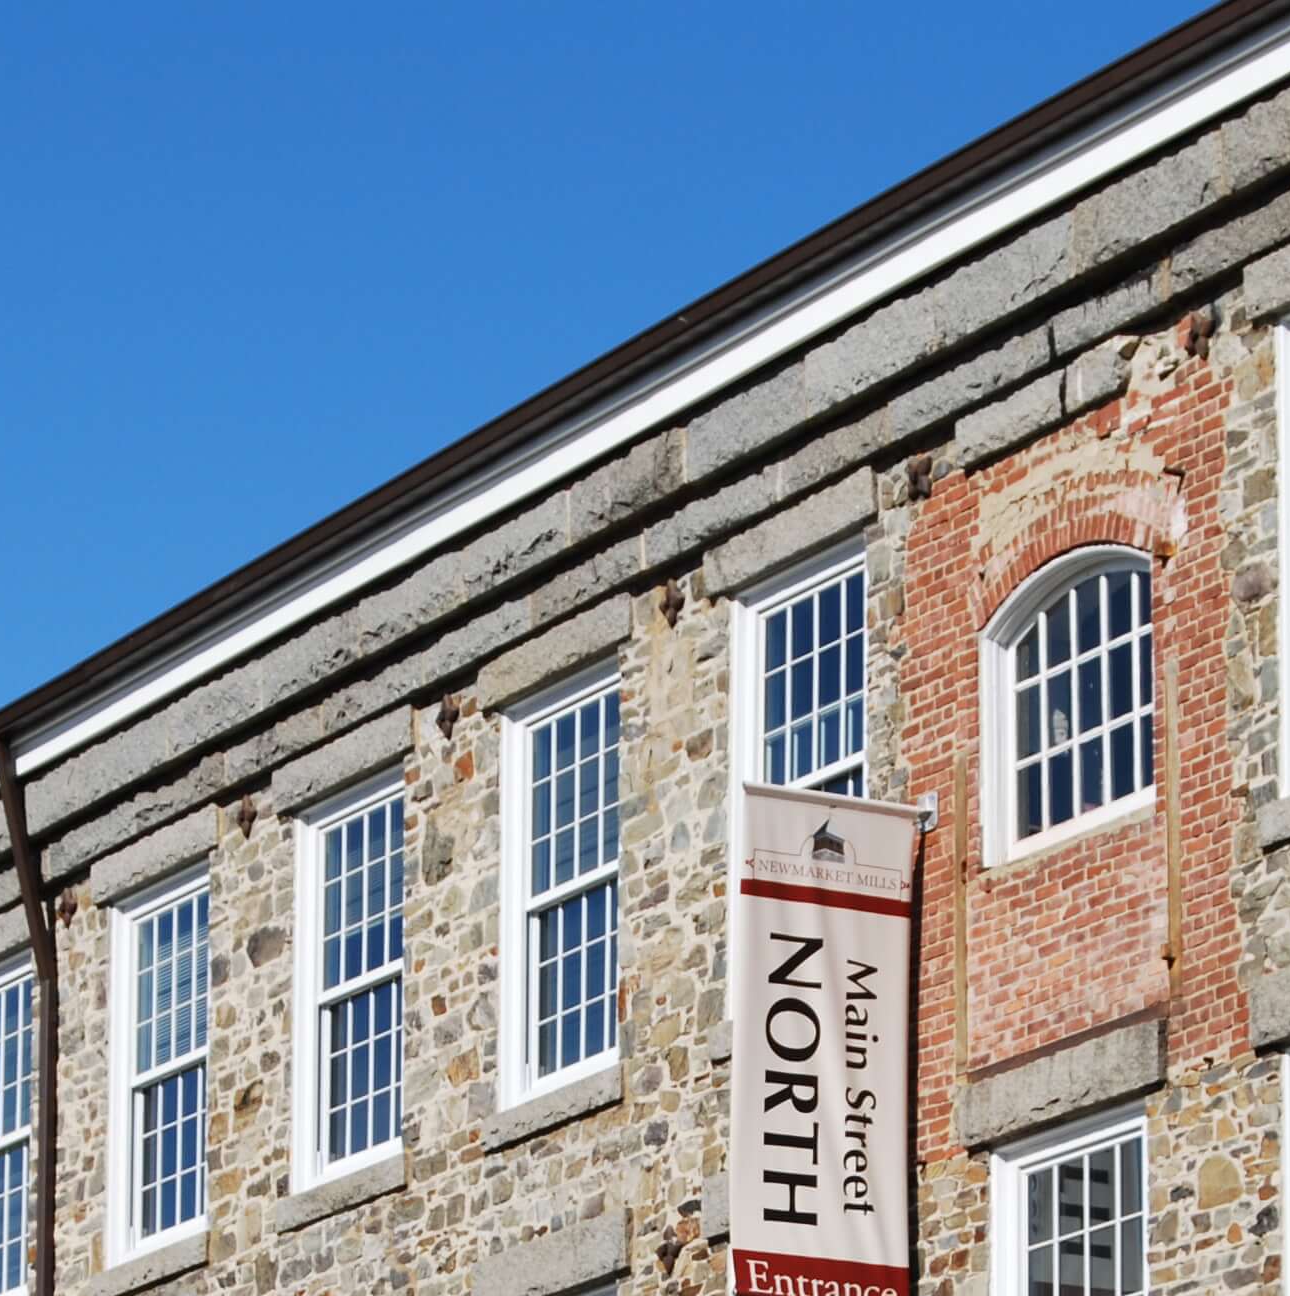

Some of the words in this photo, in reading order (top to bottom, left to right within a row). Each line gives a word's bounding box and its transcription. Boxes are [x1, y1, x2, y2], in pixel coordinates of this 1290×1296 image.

[758, 859, 853, 883] NEWMARKET
[854, 874, 897, 890] MILLS
[844, 958, 878, 1070] Main
[762, 931, 824, 1227] NORTH
[843, 1088, 877, 1217] Street
